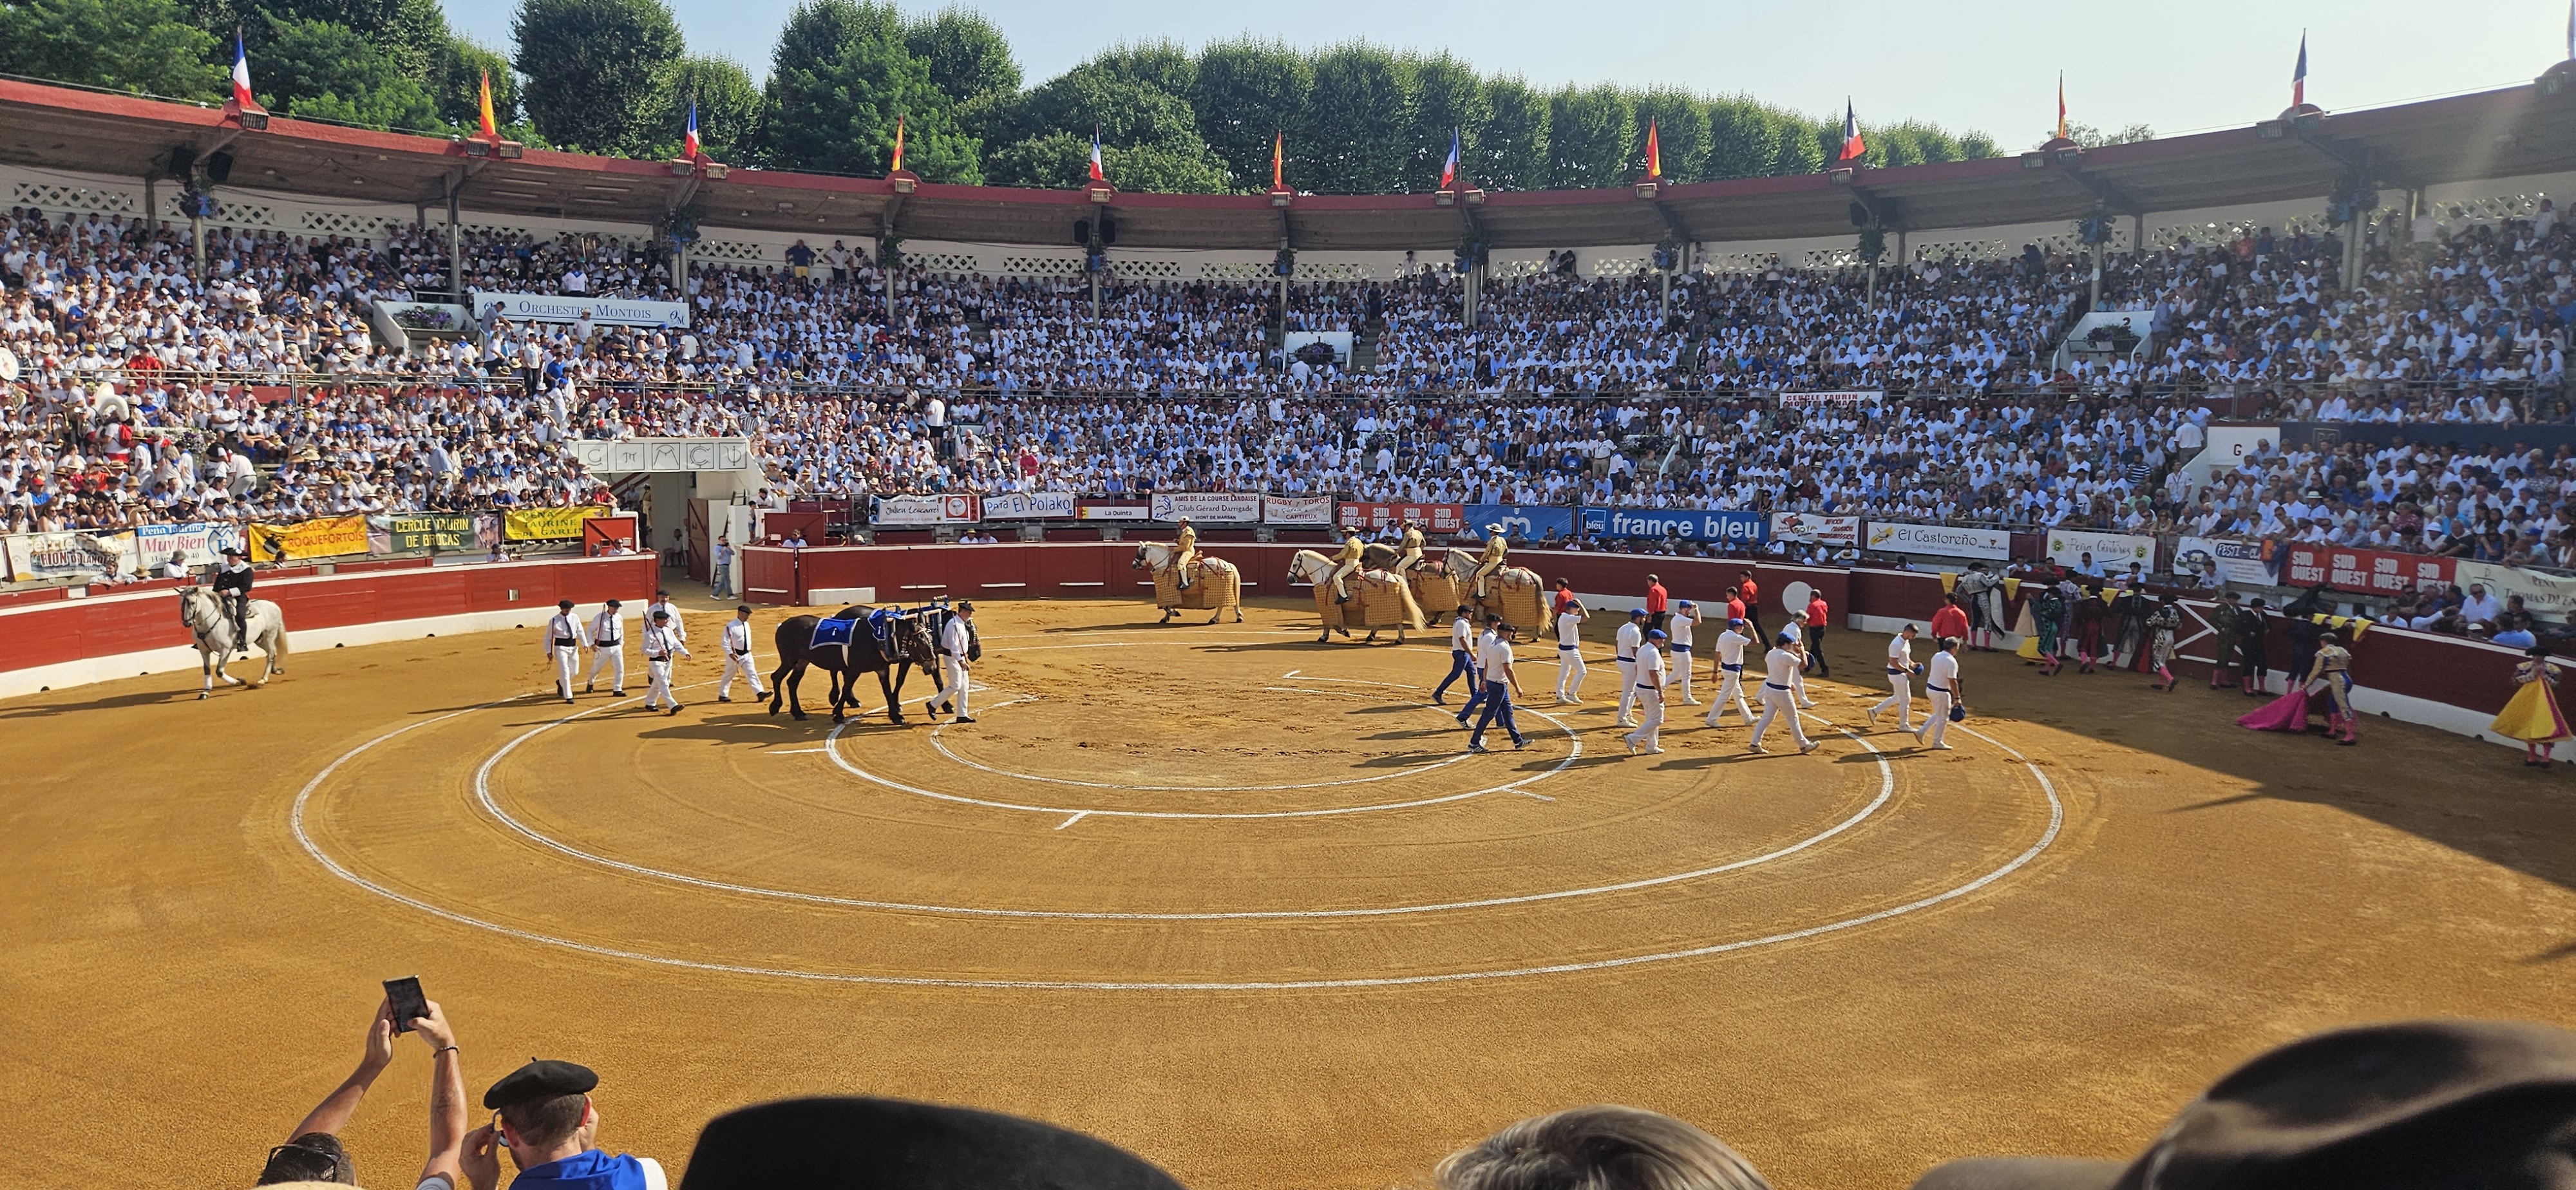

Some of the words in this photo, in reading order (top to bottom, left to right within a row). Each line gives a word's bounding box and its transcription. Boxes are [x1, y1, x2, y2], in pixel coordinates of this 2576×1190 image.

[520, 300, 590, 316] ORCHESTR
[596, 305, 651, 319] MONTOIS
[2233, 444, 2242, 456] G
[1012, 496, 1025, 513] El
[1031, 496, 1070, 511] Polako
[1266, 497, 1293, 505] RUGBY
[1222, 504, 1253, 513] Darrigade
[1341, 507, 1358, 516] SUD
[1373, 507, 1389, 517] SUD
[1404, 508, 1420, 518] SUD
[1435, 509, 1451, 518] SUD
[293, 522, 322, 533] CERCLE
[327, 518, 359, 529] TAURIN
[395, 519, 431, 533] CERCLE
[436, 518, 469, 531] TAURIN
[522, 519, 576, 528] TAURINE
[1341, 516, 1367, 527] OUEST
[1435, 518, 1460, 529] OUEST
[1586, 520, 1604, 529] bleu
[1613, 513, 1693, 536] france
[1705, 516, 1759, 538] bleu
[288, 531, 364, 547] ROQUEFORTOIS
[405, 535, 419, 548] DE
[422, 534, 460, 547] BROCAS
[1899, 529, 1911, 541] El
[1915, 529, 1977, 545] Castoreño
[23, 538, 75, 553] Cercle
[144, 538, 174, 555] Muy
[177, 536, 205, 550] Bien
[2067, 538, 2092, 552] Peña
[2217, 544, 2241, 556] FESTI
[40, 552, 68, 566] RION
[2292, 551, 2313, 566] SUD
[2333, 554, 2356, 570] SUD
[2374, 558, 2398, 574] SUD
[2418, 563, 2439, 579] SUD
[2291, 566, 2325, 582] OUEST
[2331, 569, 2368, 586] OUEST
